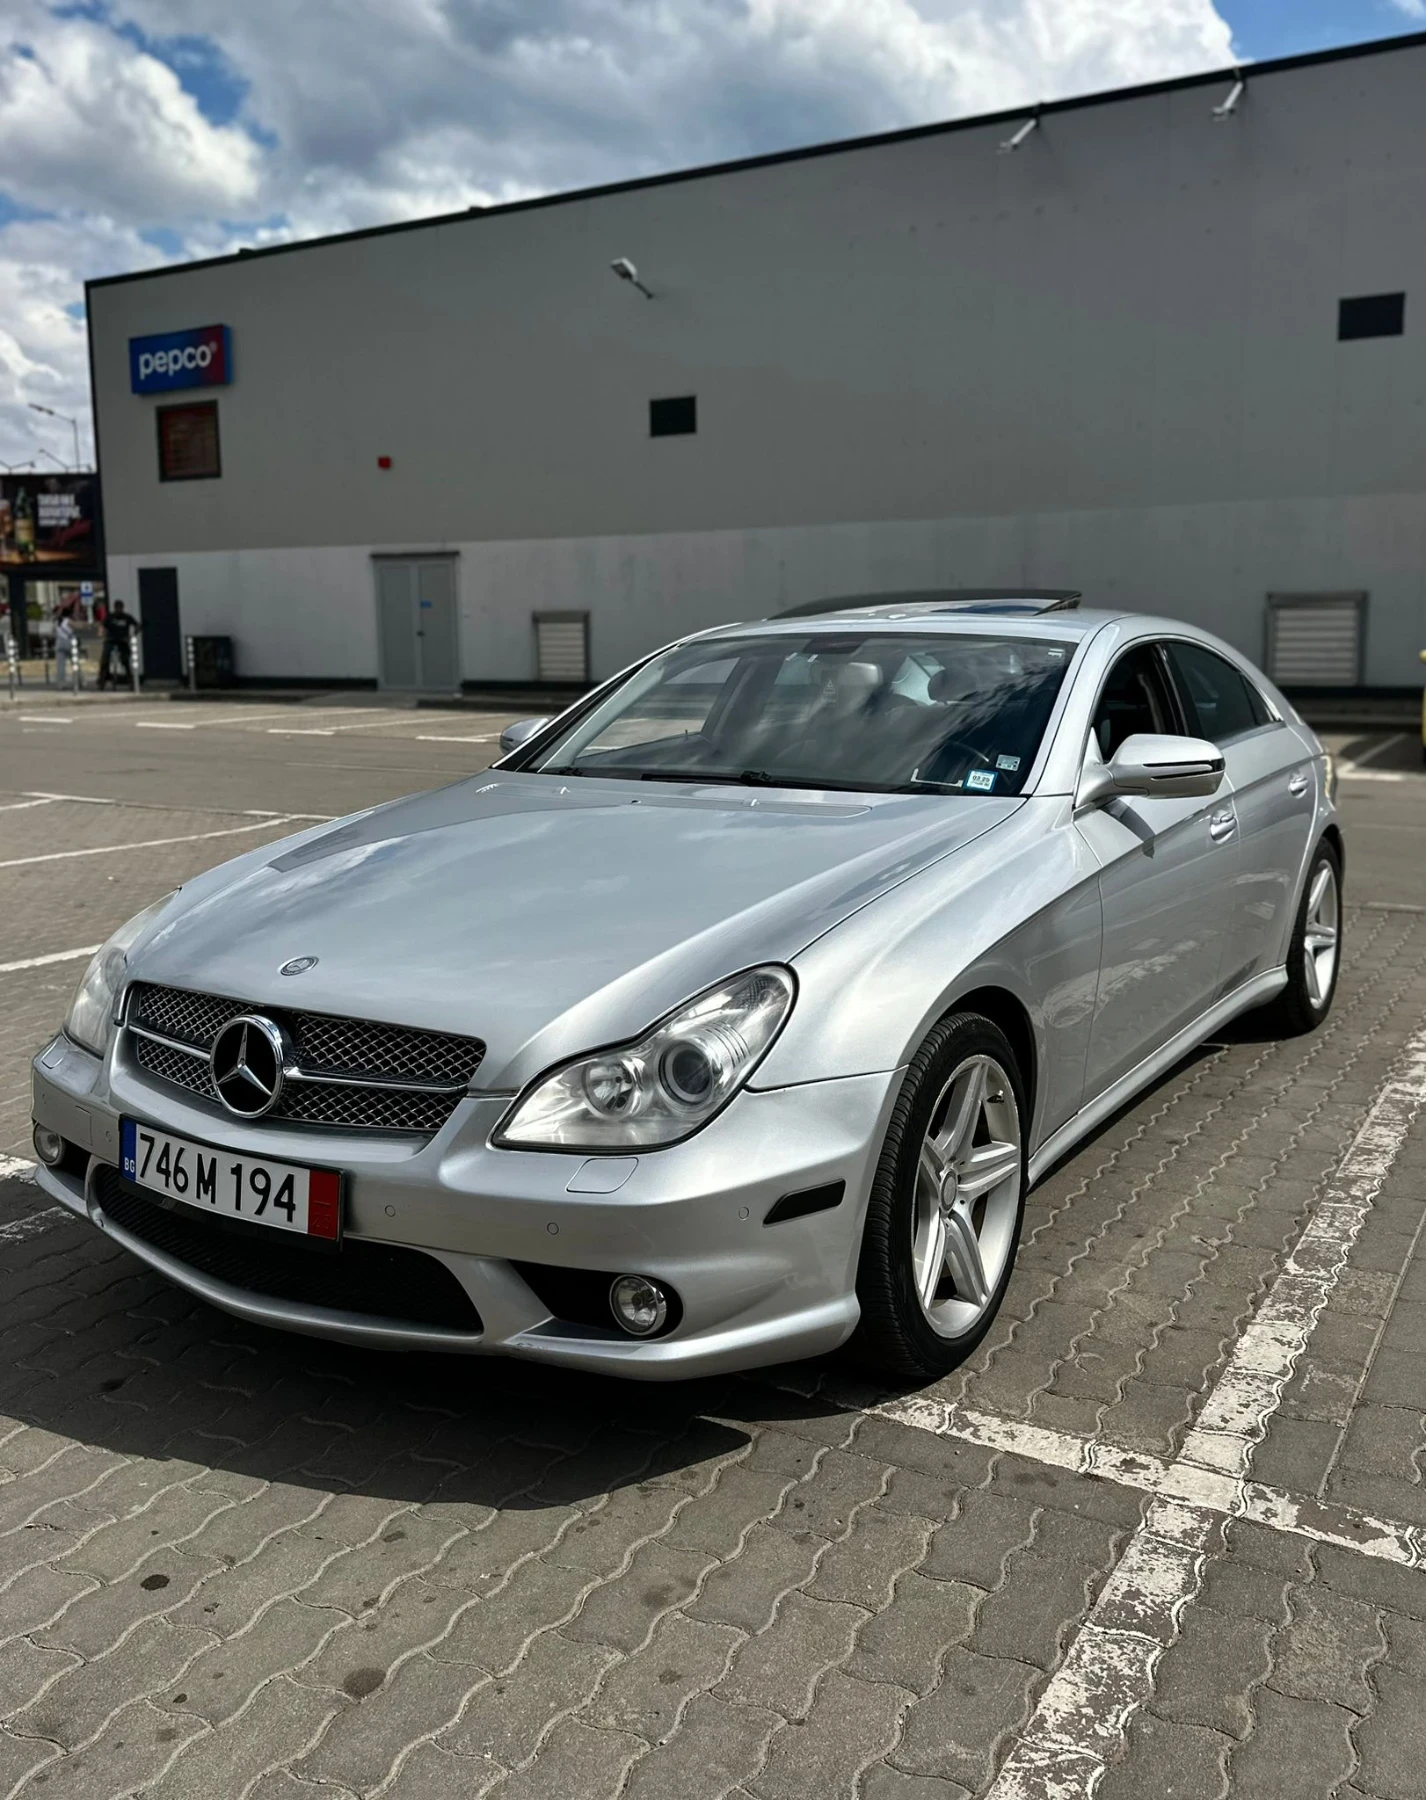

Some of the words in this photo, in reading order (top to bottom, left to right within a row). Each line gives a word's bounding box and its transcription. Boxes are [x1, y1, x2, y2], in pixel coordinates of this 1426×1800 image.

[139, 344, 212, 381] pepco
[124, 1157, 135, 1173] BG
[139, 1133, 189, 1193] 746
[196, 1153, 217, 1204] M
[230, 1163, 296, 1223] 194
